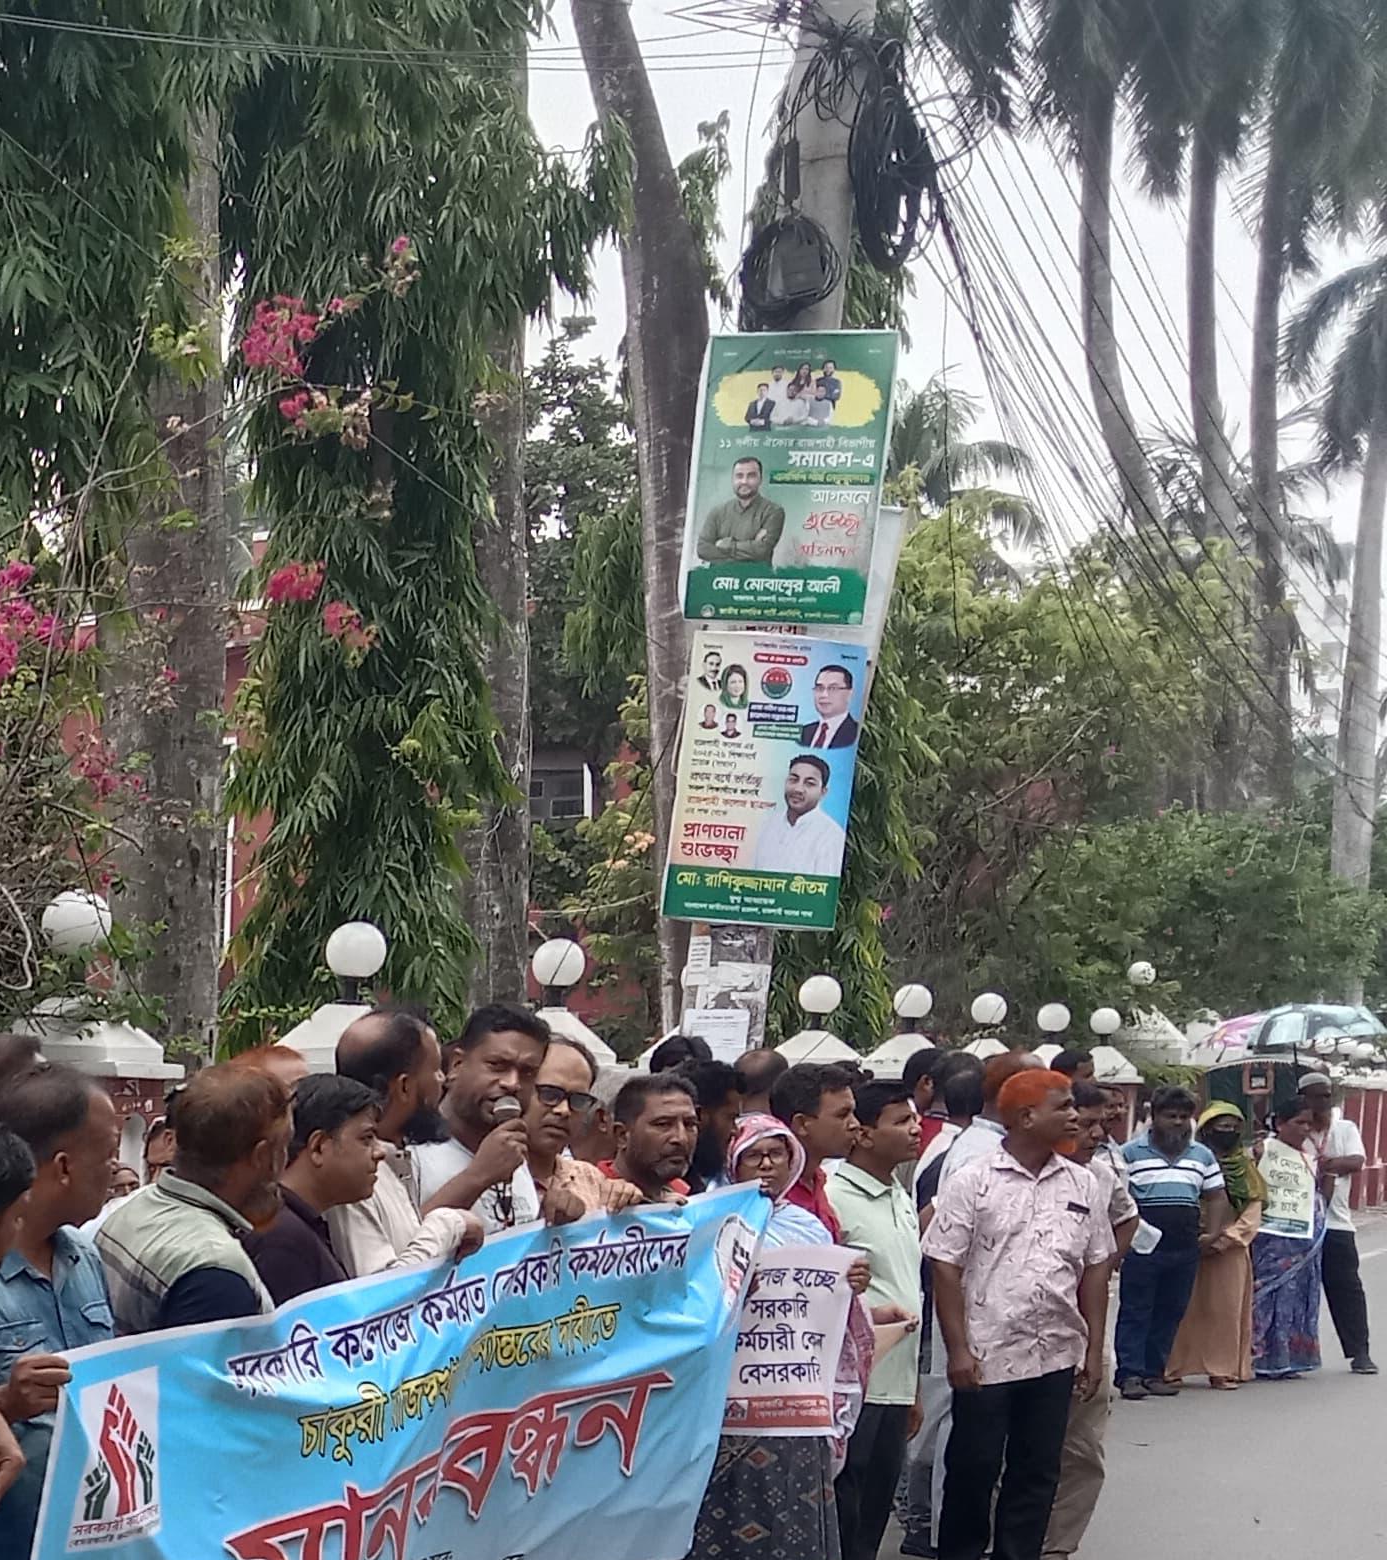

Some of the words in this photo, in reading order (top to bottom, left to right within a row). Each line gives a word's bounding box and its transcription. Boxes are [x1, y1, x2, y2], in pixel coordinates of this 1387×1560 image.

[788, 450, 875, 468] সমাবেশ-এ
[811, 489, 871, 505] আগমনে
[713, 576, 739, 591] মোঃ
[807, 575, 841, 594] আলী
[683, 822, 746, 841] প্রাণঢালা
[681, 842, 739, 864] শুভেচ্ছা
[793, 1267, 839, 1293] হচ্ছে
[325, 1303, 417, 1370] কলেজে
[417, 1269, 488, 1335] কর্মরত
[567, 1225, 691, 1282] কর্মচারীদের
[750, 1293, 810, 1320] সরকারি
[298, 1380, 390, 1467] চাকুরী
